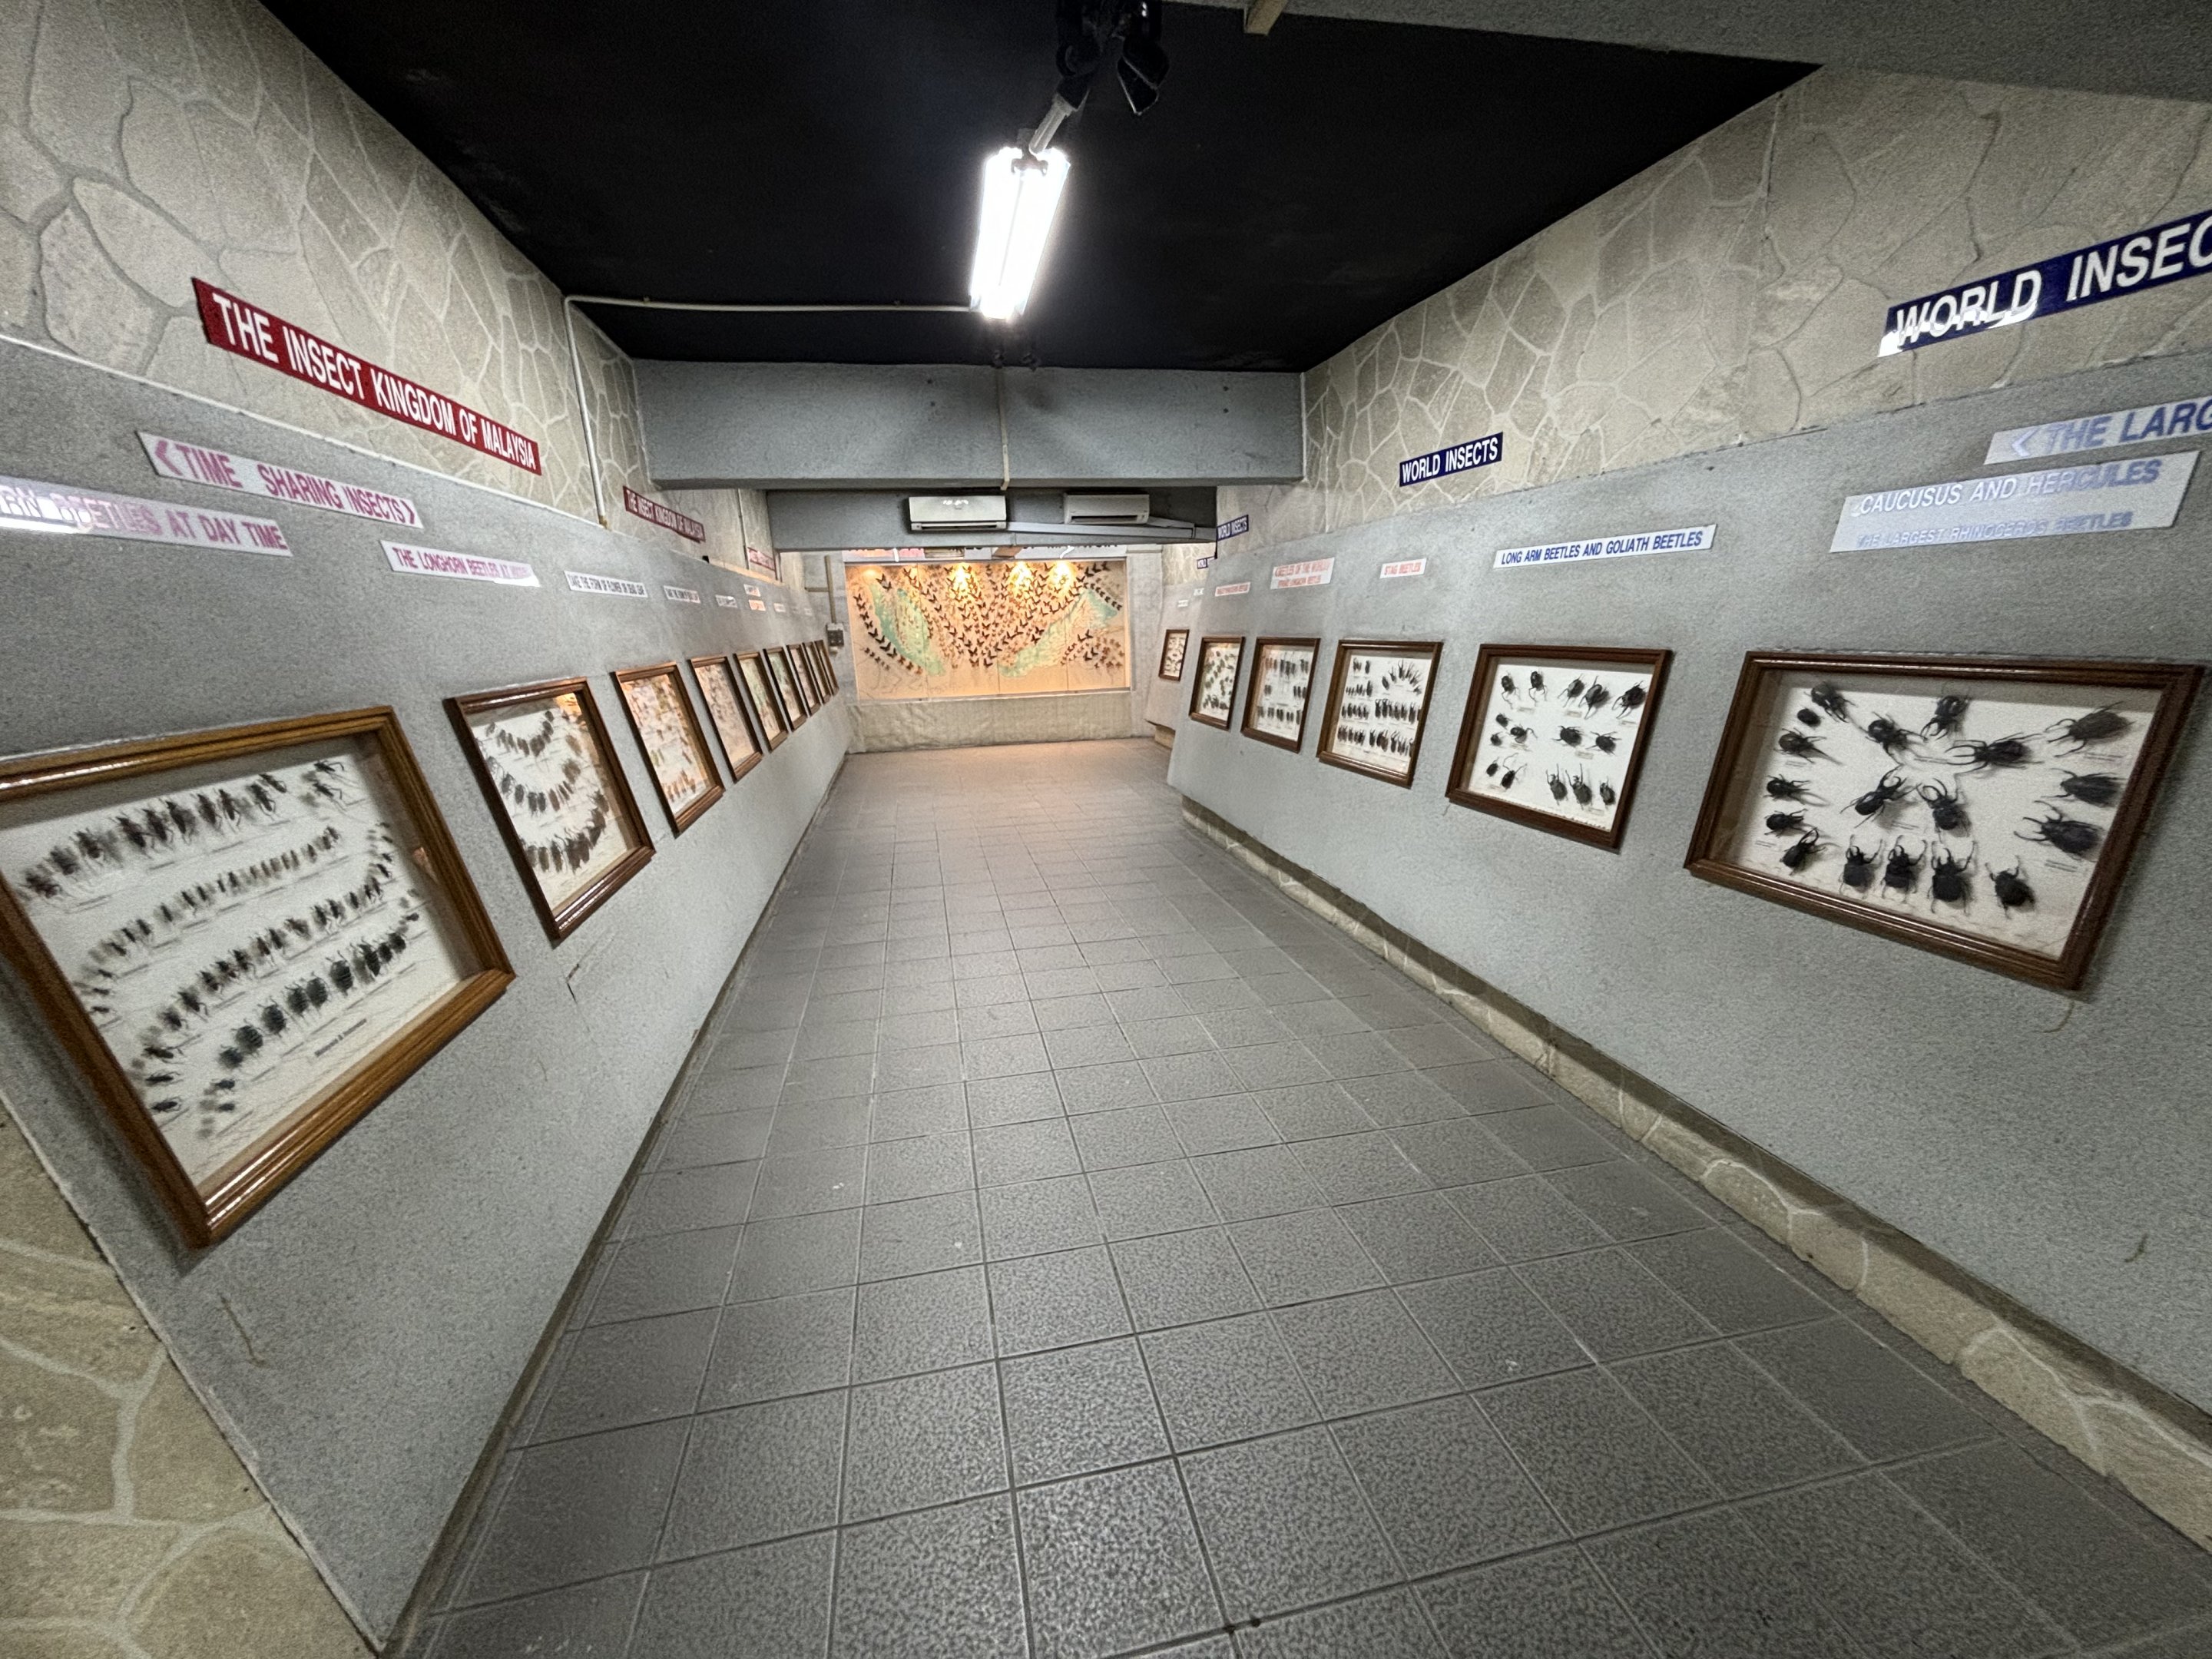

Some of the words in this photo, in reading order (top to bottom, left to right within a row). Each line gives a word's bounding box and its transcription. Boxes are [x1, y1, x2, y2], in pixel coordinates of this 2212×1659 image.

[1896, 270, 2042, 346] WORLD
[212, 293, 279, 363] THE
[282, 326, 365, 400] INSECT
[370, 368, 456, 436] KINGDOM
[459, 408, 478, 445] OF
[481, 419, 536, 470] MALAYSIA
[2045, 416, 2114, 455] THE
[174, 443, 243, 488] TIME
[257, 463, 344, 509] SHARING
[1402, 454, 1441, 484] WORLD
[1445, 437, 1498, 472] INSECTS
[1859, 483, 1963, 515] CAUCUSUS
[1969, 478, 2018, 502] AND
[165, 509, 197, 539] AT
[197, 514, 241, 545] DAY
[242, 522, 289, 550] TIME
[1501, 551, 1523, 565] LONG
[1524, 548, 1542, 562] ARM
[1543, 545, 1581, 561] BEETLES
[1582, 541, 1603, 558] AND
[1606, 537, 1650, 555] GOLIATH
[1652, 530, 1704, 551] BEETLES
[392, 547, 419, 569] THE
[416, 551, 469, 575] LONGHORN
